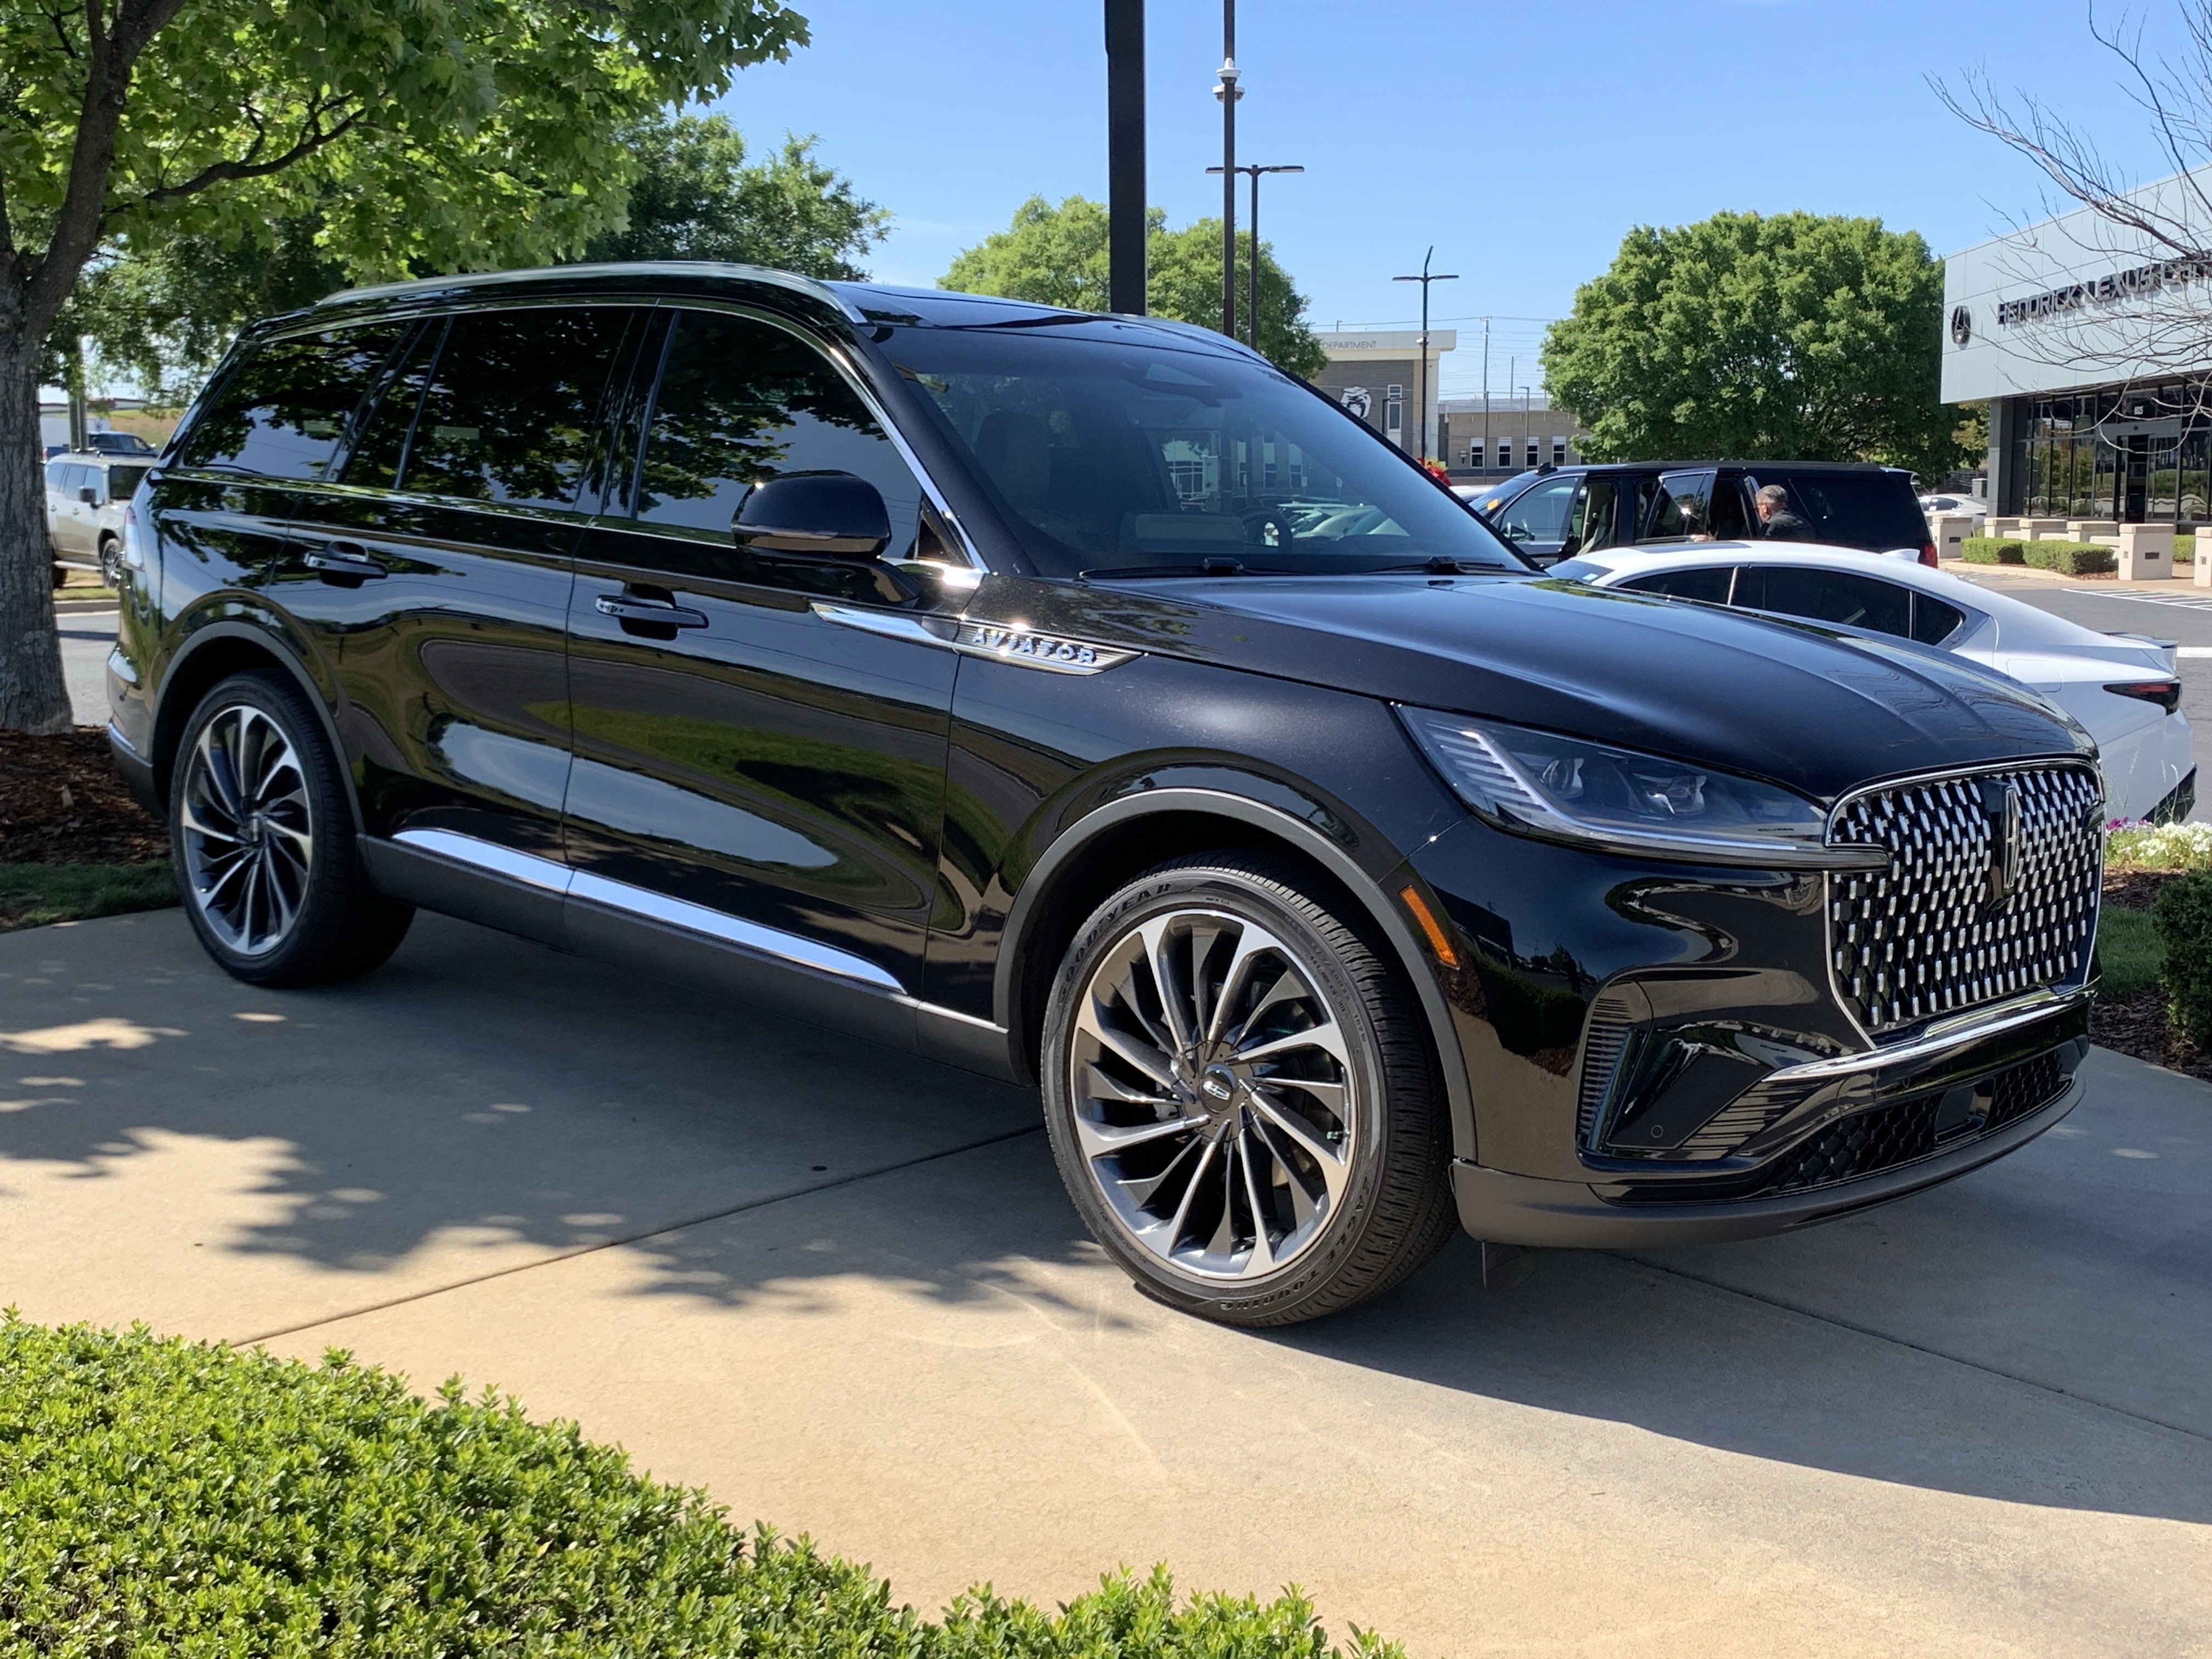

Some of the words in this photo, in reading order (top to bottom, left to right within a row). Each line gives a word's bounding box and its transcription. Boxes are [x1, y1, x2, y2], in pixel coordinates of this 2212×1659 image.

[1997, 284, 2085, 325] HENDRICK
[2086, 264, 2160, 302] LEXUS
[1322, 341, 1377, 350] DEPARTMENT
[971, 628, 1097, 664] AVIATOR
[1058, 883, 1172, 1006] GOODYEAR
[1324, 1175, 1370, 1263] EAGLE
[1220, 1268, 1320, 1311] TOURING
